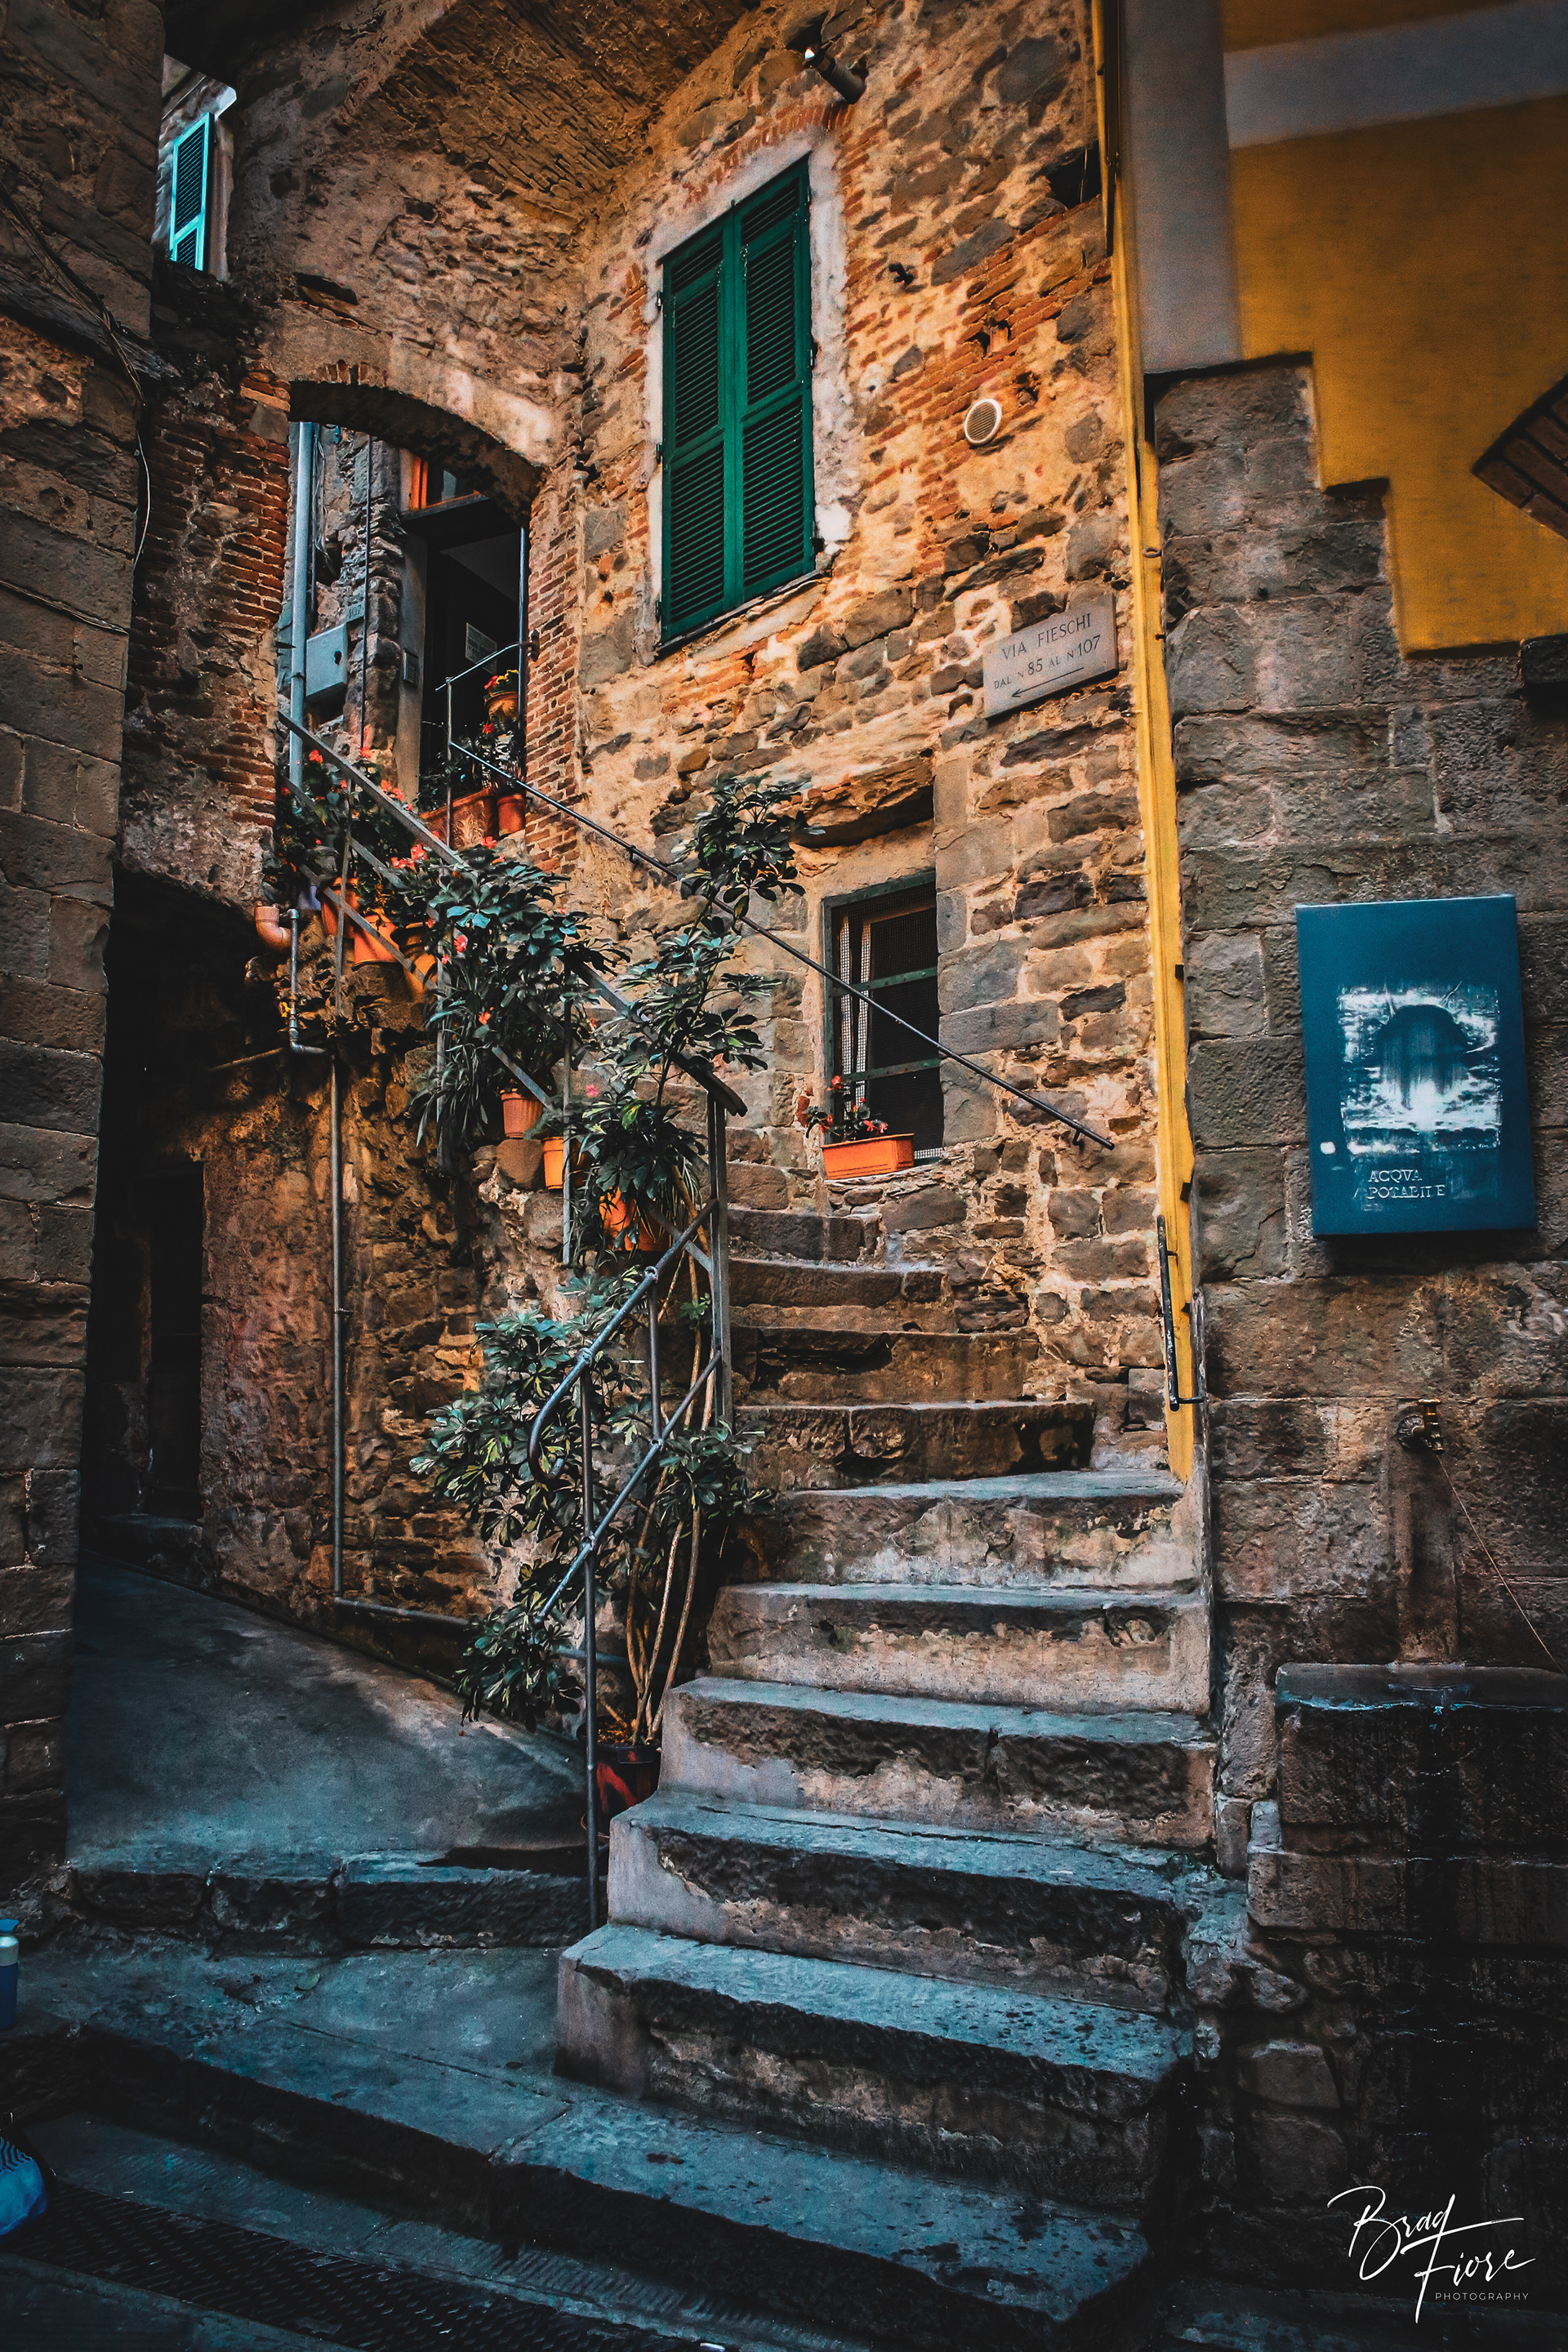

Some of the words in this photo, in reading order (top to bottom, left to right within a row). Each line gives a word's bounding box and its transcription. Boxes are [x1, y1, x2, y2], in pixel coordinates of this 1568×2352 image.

[1002, 641, 1027, 660] VIA
[1037, 613, 1091, 648] FIESCHI
[994, 676, 1012, 689] DAL
[1027, 658, 1043, 675] 85
[1049, 656, 1061, 669] AL
[1077, 635, 1101, 657] 107
[1368, 1169, 1422, 1183] ACQVA
